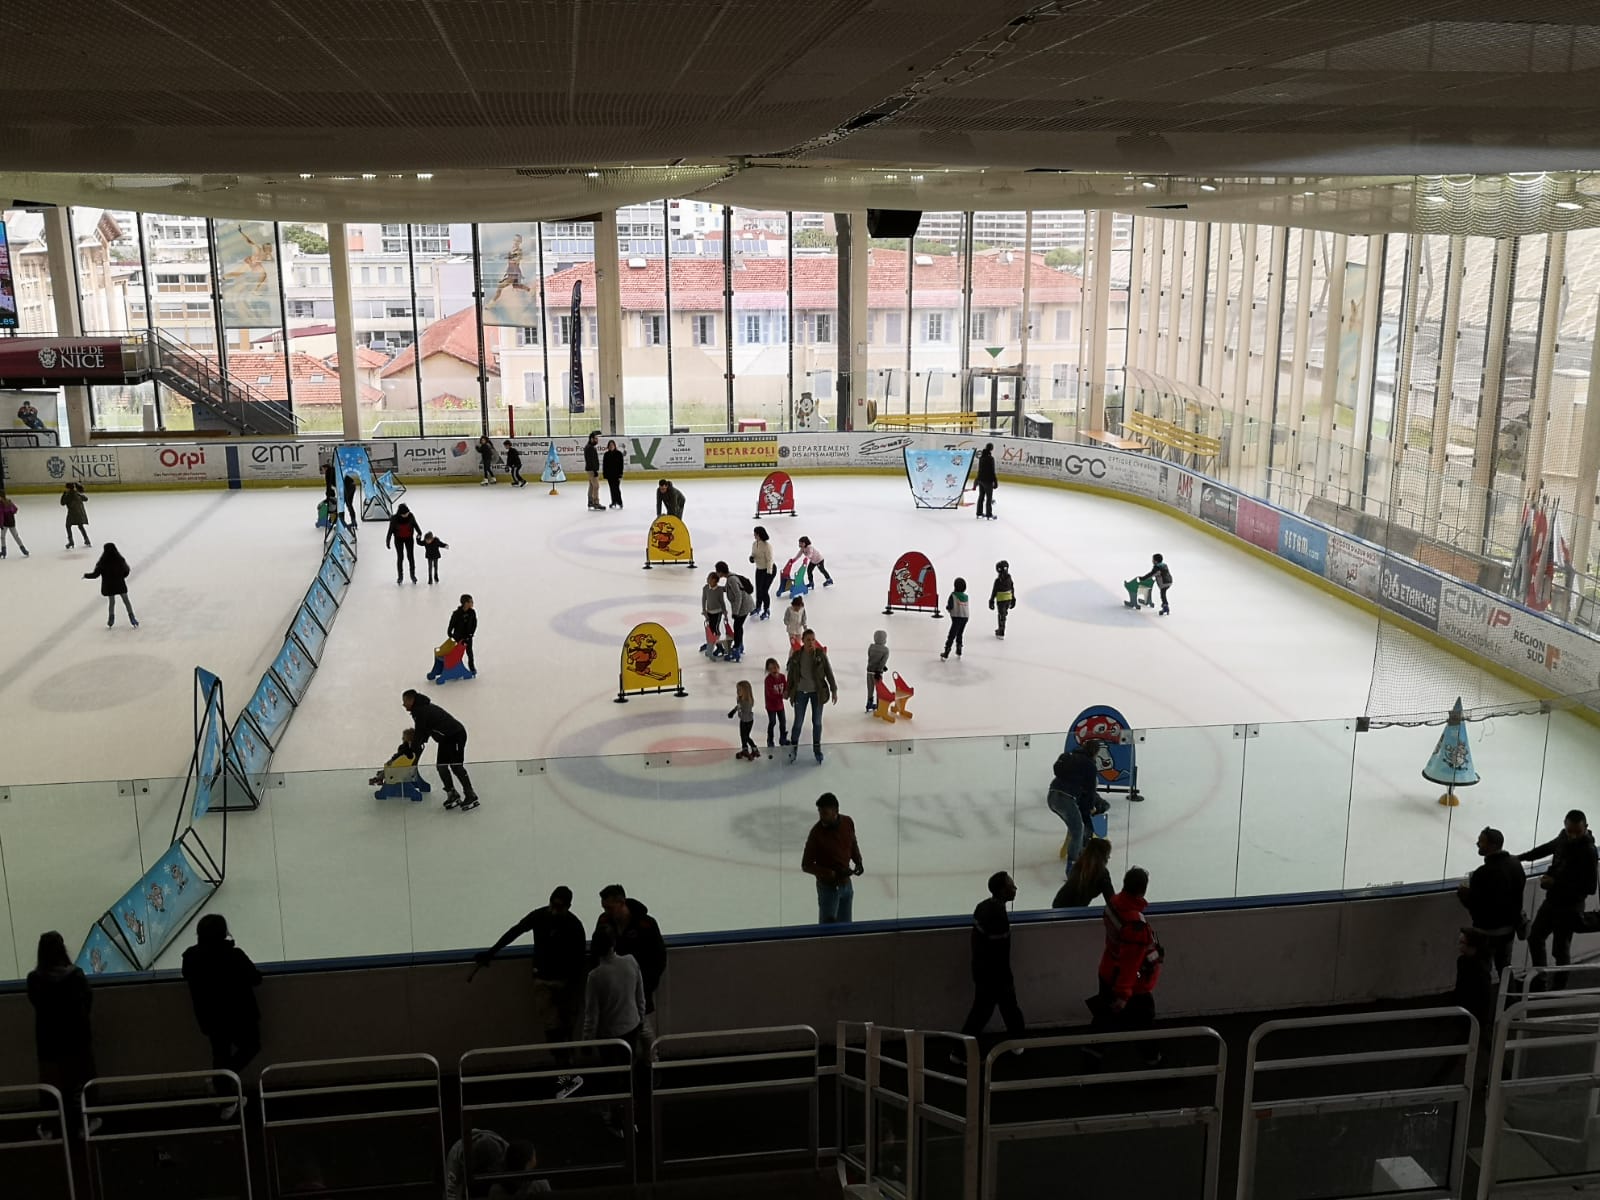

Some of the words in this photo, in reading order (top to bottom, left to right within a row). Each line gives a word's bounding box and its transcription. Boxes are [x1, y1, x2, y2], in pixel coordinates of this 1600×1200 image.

[58, 346, 87, 354] VILLE
[89, 345, 103, 354] DE
[61, 354, 104, 368] NICE
[69, 455, 97, 463] VILLE
[100, 454, 114, 462] DE
[160, 447, 205, 469] Orpi
[252, 445, 304, 462] emr
[404, 448, 446, 457] ADIM
[706, 447, 775, 456] PESCARZOLI
[72, 463, 116, 478] NICE
[1177, 472, 1194, 500] AMS
[1526, 649, 1544, 664] SUD
